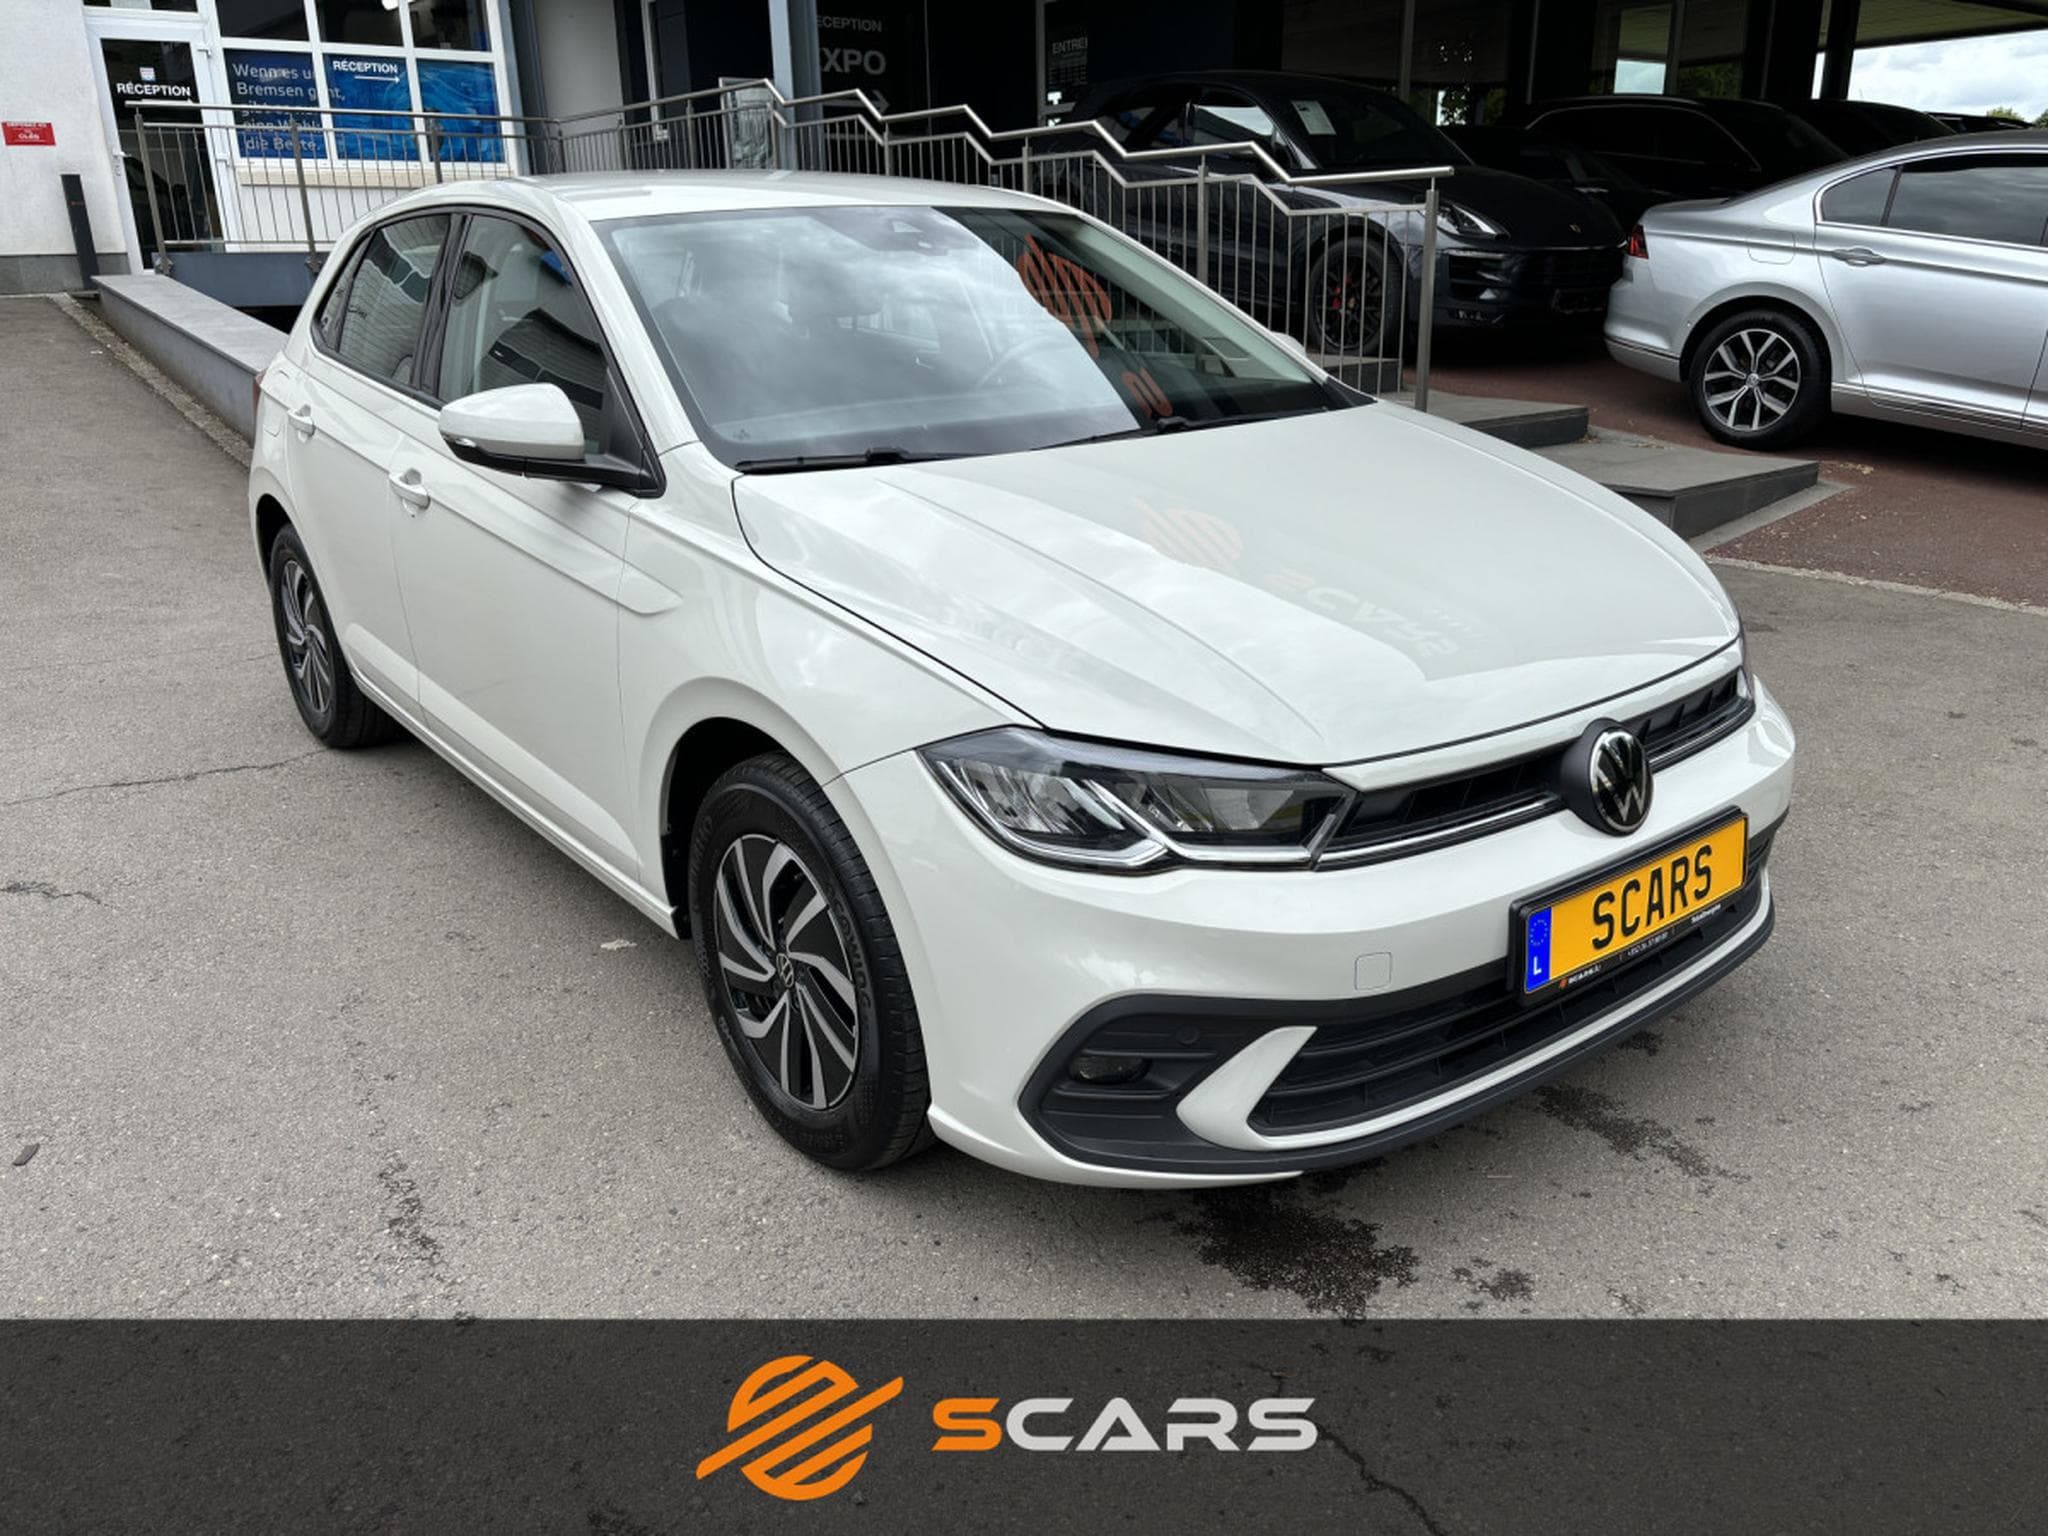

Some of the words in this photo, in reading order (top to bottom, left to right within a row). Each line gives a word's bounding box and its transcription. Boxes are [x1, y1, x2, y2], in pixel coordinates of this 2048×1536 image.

[333, 58, 398, 74] RÉCEPTION
[822, 47, 887, 76] XPO
[232, 63, 278, 79] Wenn
[116, 81, 191, 97] RÉCEPTION
[236, 81, 304, 97] Bremsen
[273, 137, 321, 152] Bete.
[1591, 844, 1713, 951] SCARS
[1532, 955, 1543, 976] L
